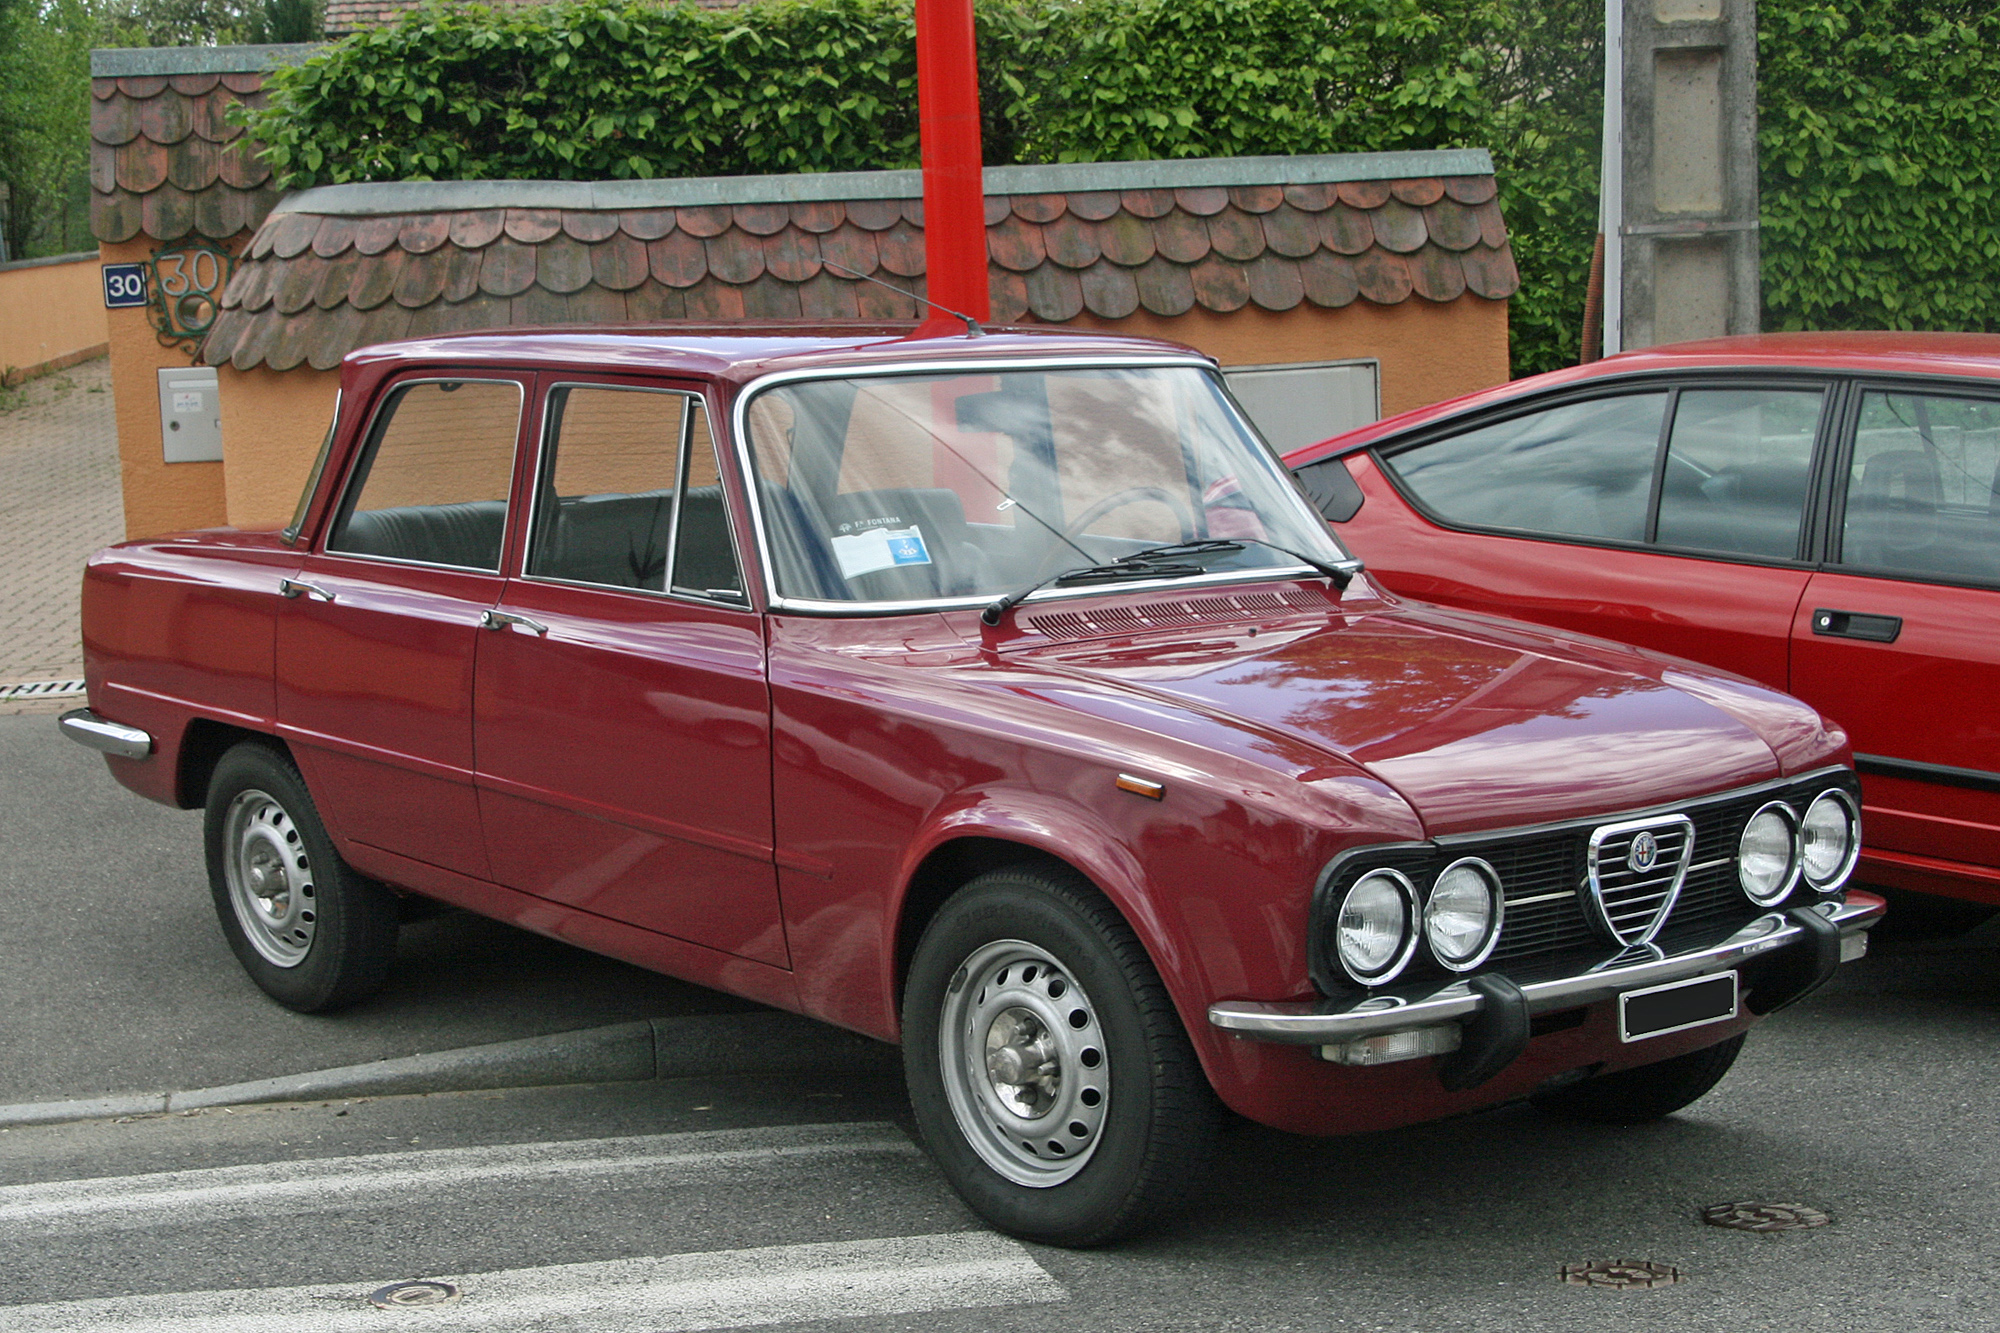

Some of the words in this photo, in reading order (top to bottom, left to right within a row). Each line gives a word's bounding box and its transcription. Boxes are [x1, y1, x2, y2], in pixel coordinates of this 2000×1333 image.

[108, 273, 142, 297] 30
[160, 250, 219, 296] 30
[867, 516, 902, 526] FONTANA
